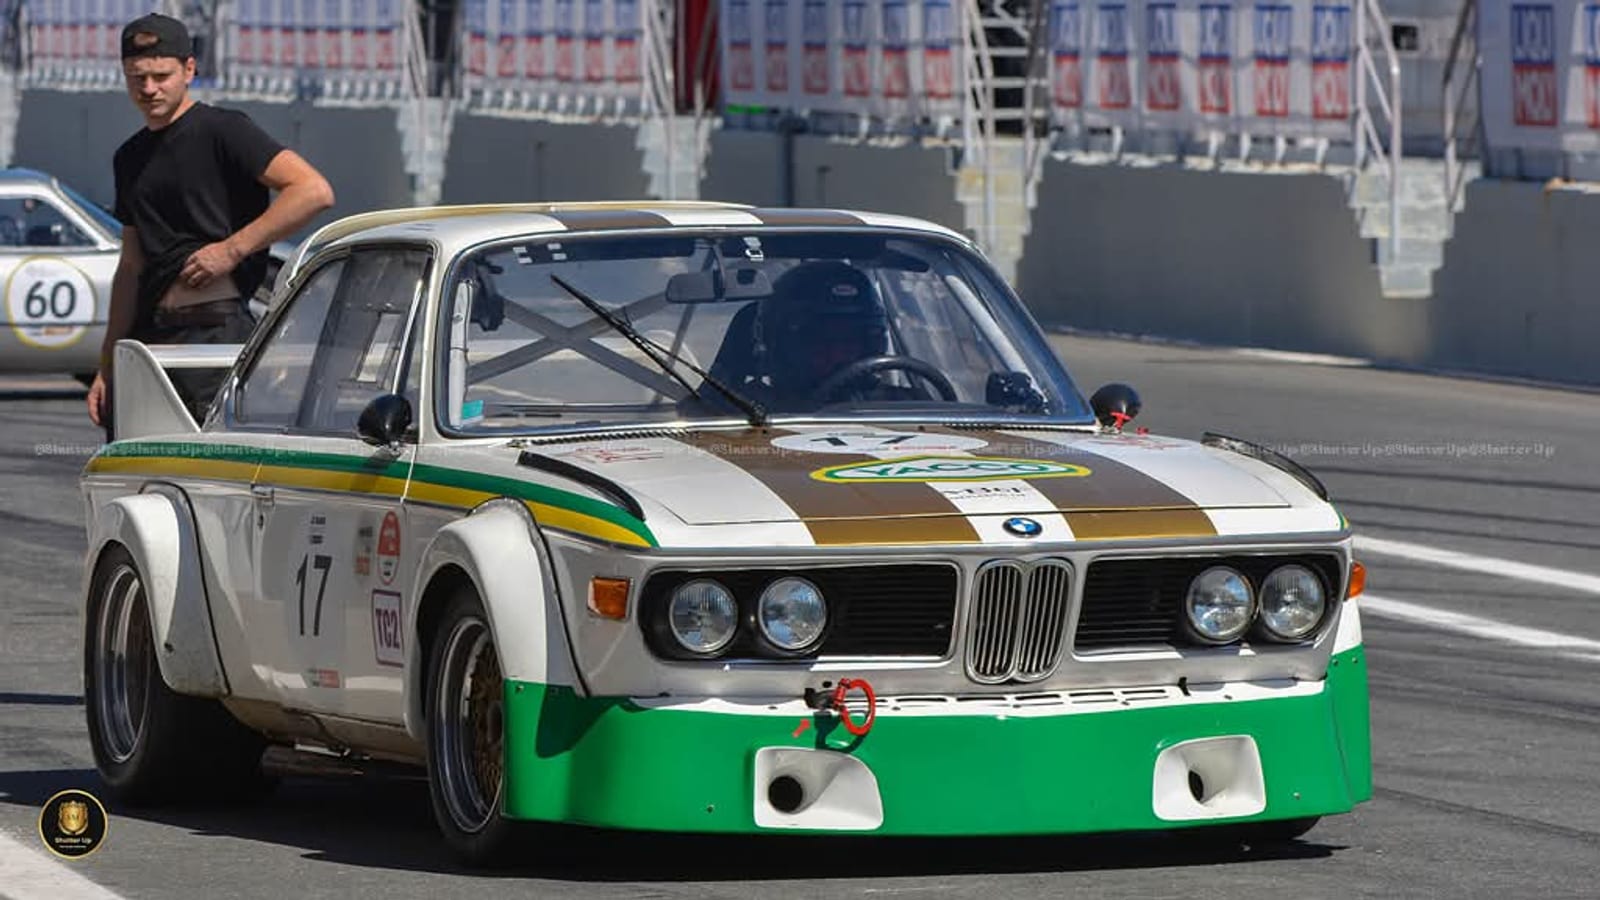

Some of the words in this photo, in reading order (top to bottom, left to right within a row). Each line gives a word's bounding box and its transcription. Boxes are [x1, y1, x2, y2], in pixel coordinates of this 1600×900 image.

[25, 281, 77, 319] 60
[855, 462, 1048, 477] YACCO
[296, 553, 332, 636] 17
[375, 607, 400, 649] TC2
